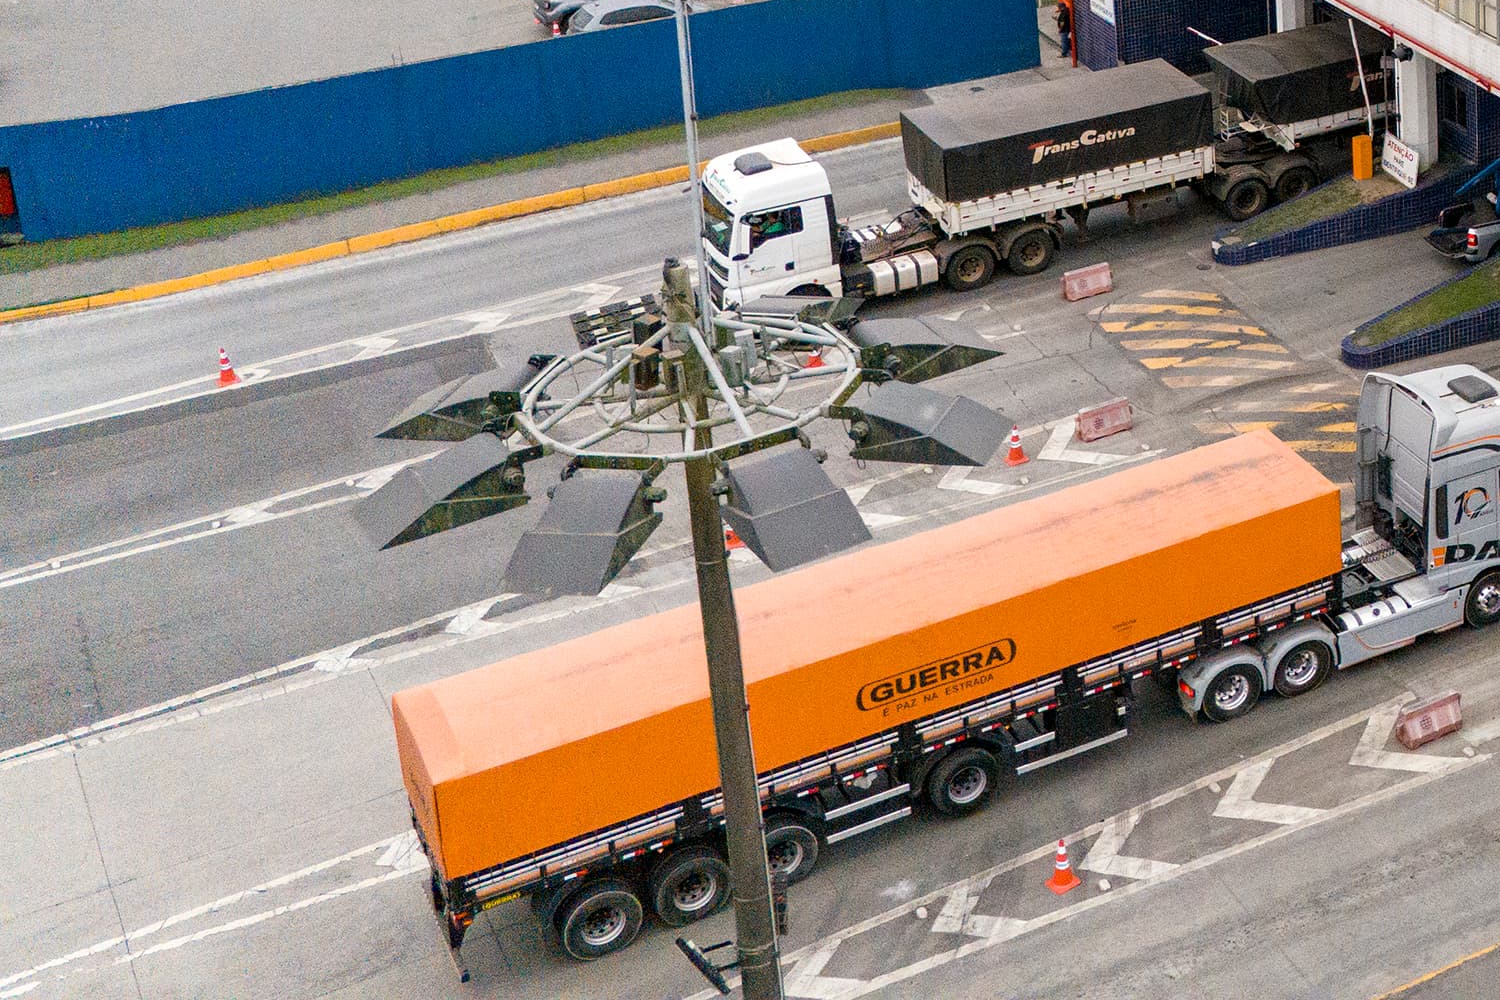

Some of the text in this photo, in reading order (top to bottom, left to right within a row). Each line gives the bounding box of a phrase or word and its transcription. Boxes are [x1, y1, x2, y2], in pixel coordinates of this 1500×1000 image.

[870, 646, 1005, 703] GUERRA
[896, 698, 917, 713] PAZ
[923, 692, 938, 704] NA
[945, 673, 994, 697] ESTRADA
